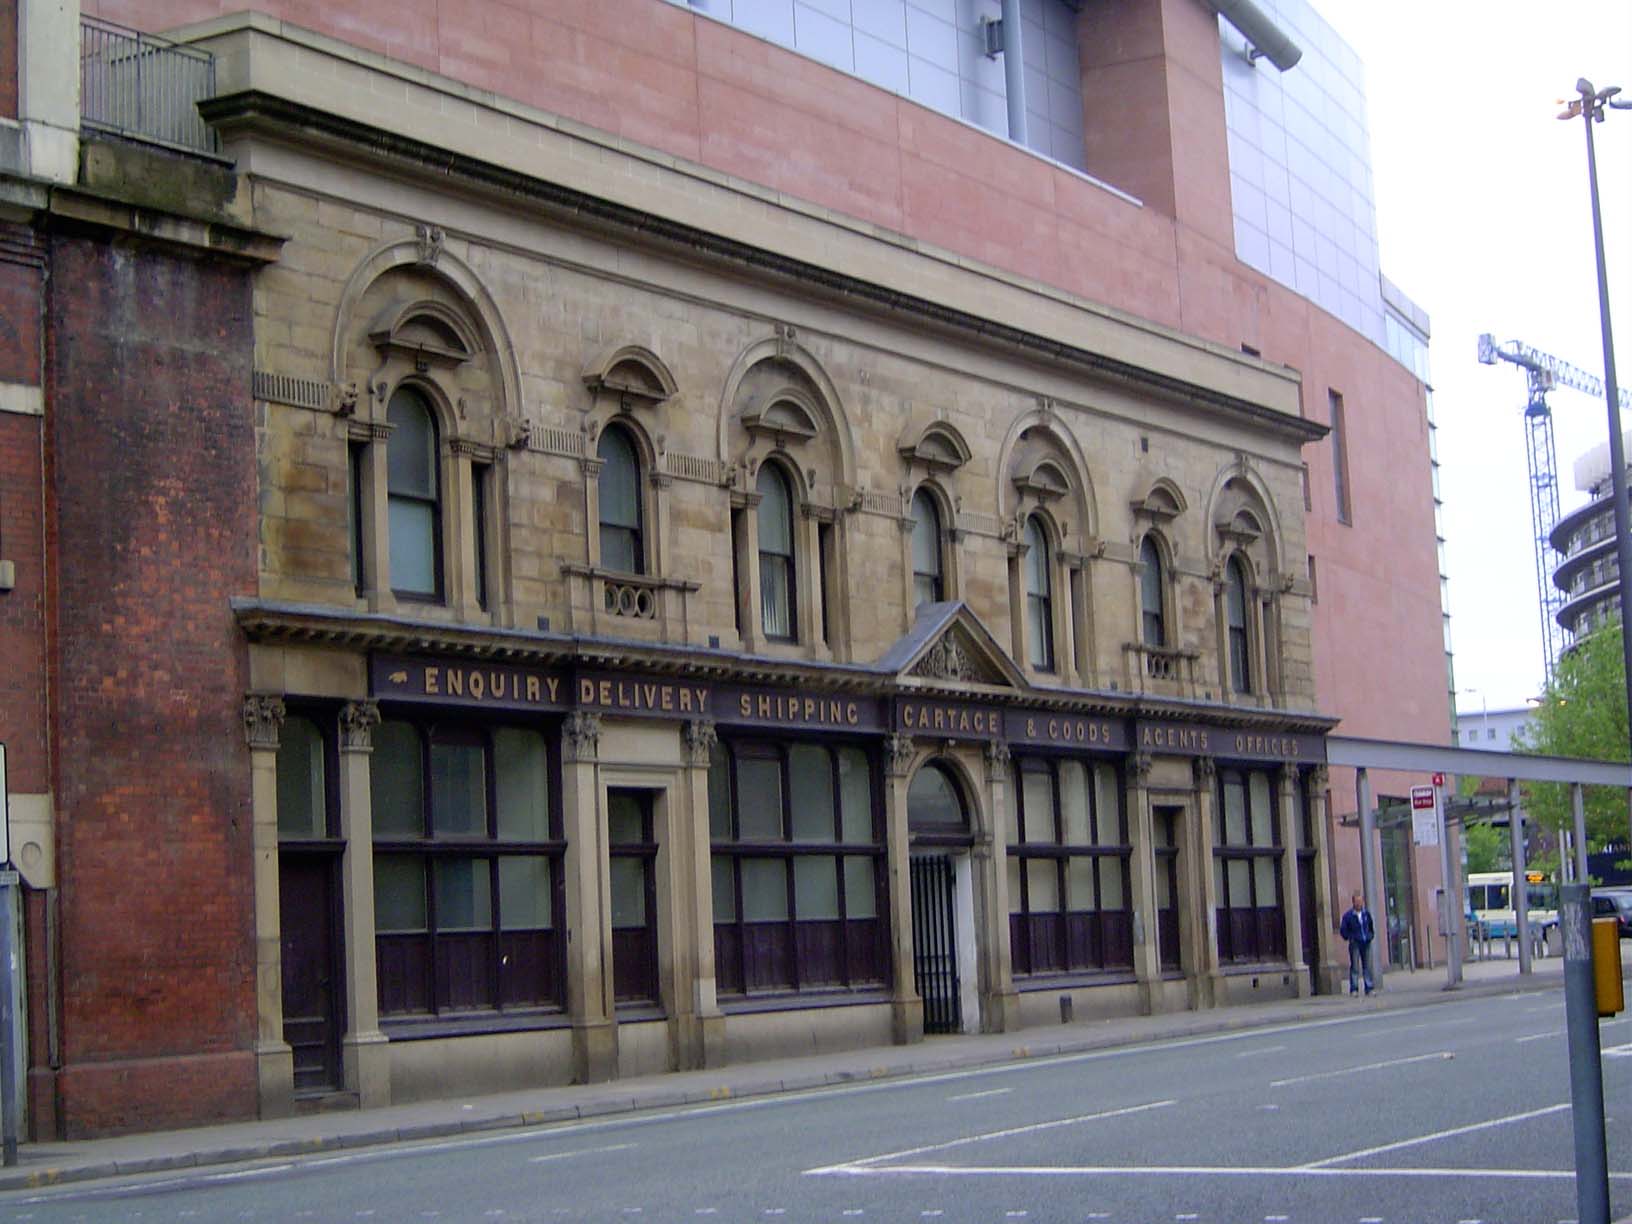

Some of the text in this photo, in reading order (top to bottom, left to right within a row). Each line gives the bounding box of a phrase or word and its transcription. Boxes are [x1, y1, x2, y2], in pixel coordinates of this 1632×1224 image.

[425, 667, 1299, 756] ENQUIRY DELIVERY SHIPPING CARTAGE & GOODS AGENTS OFFICES
